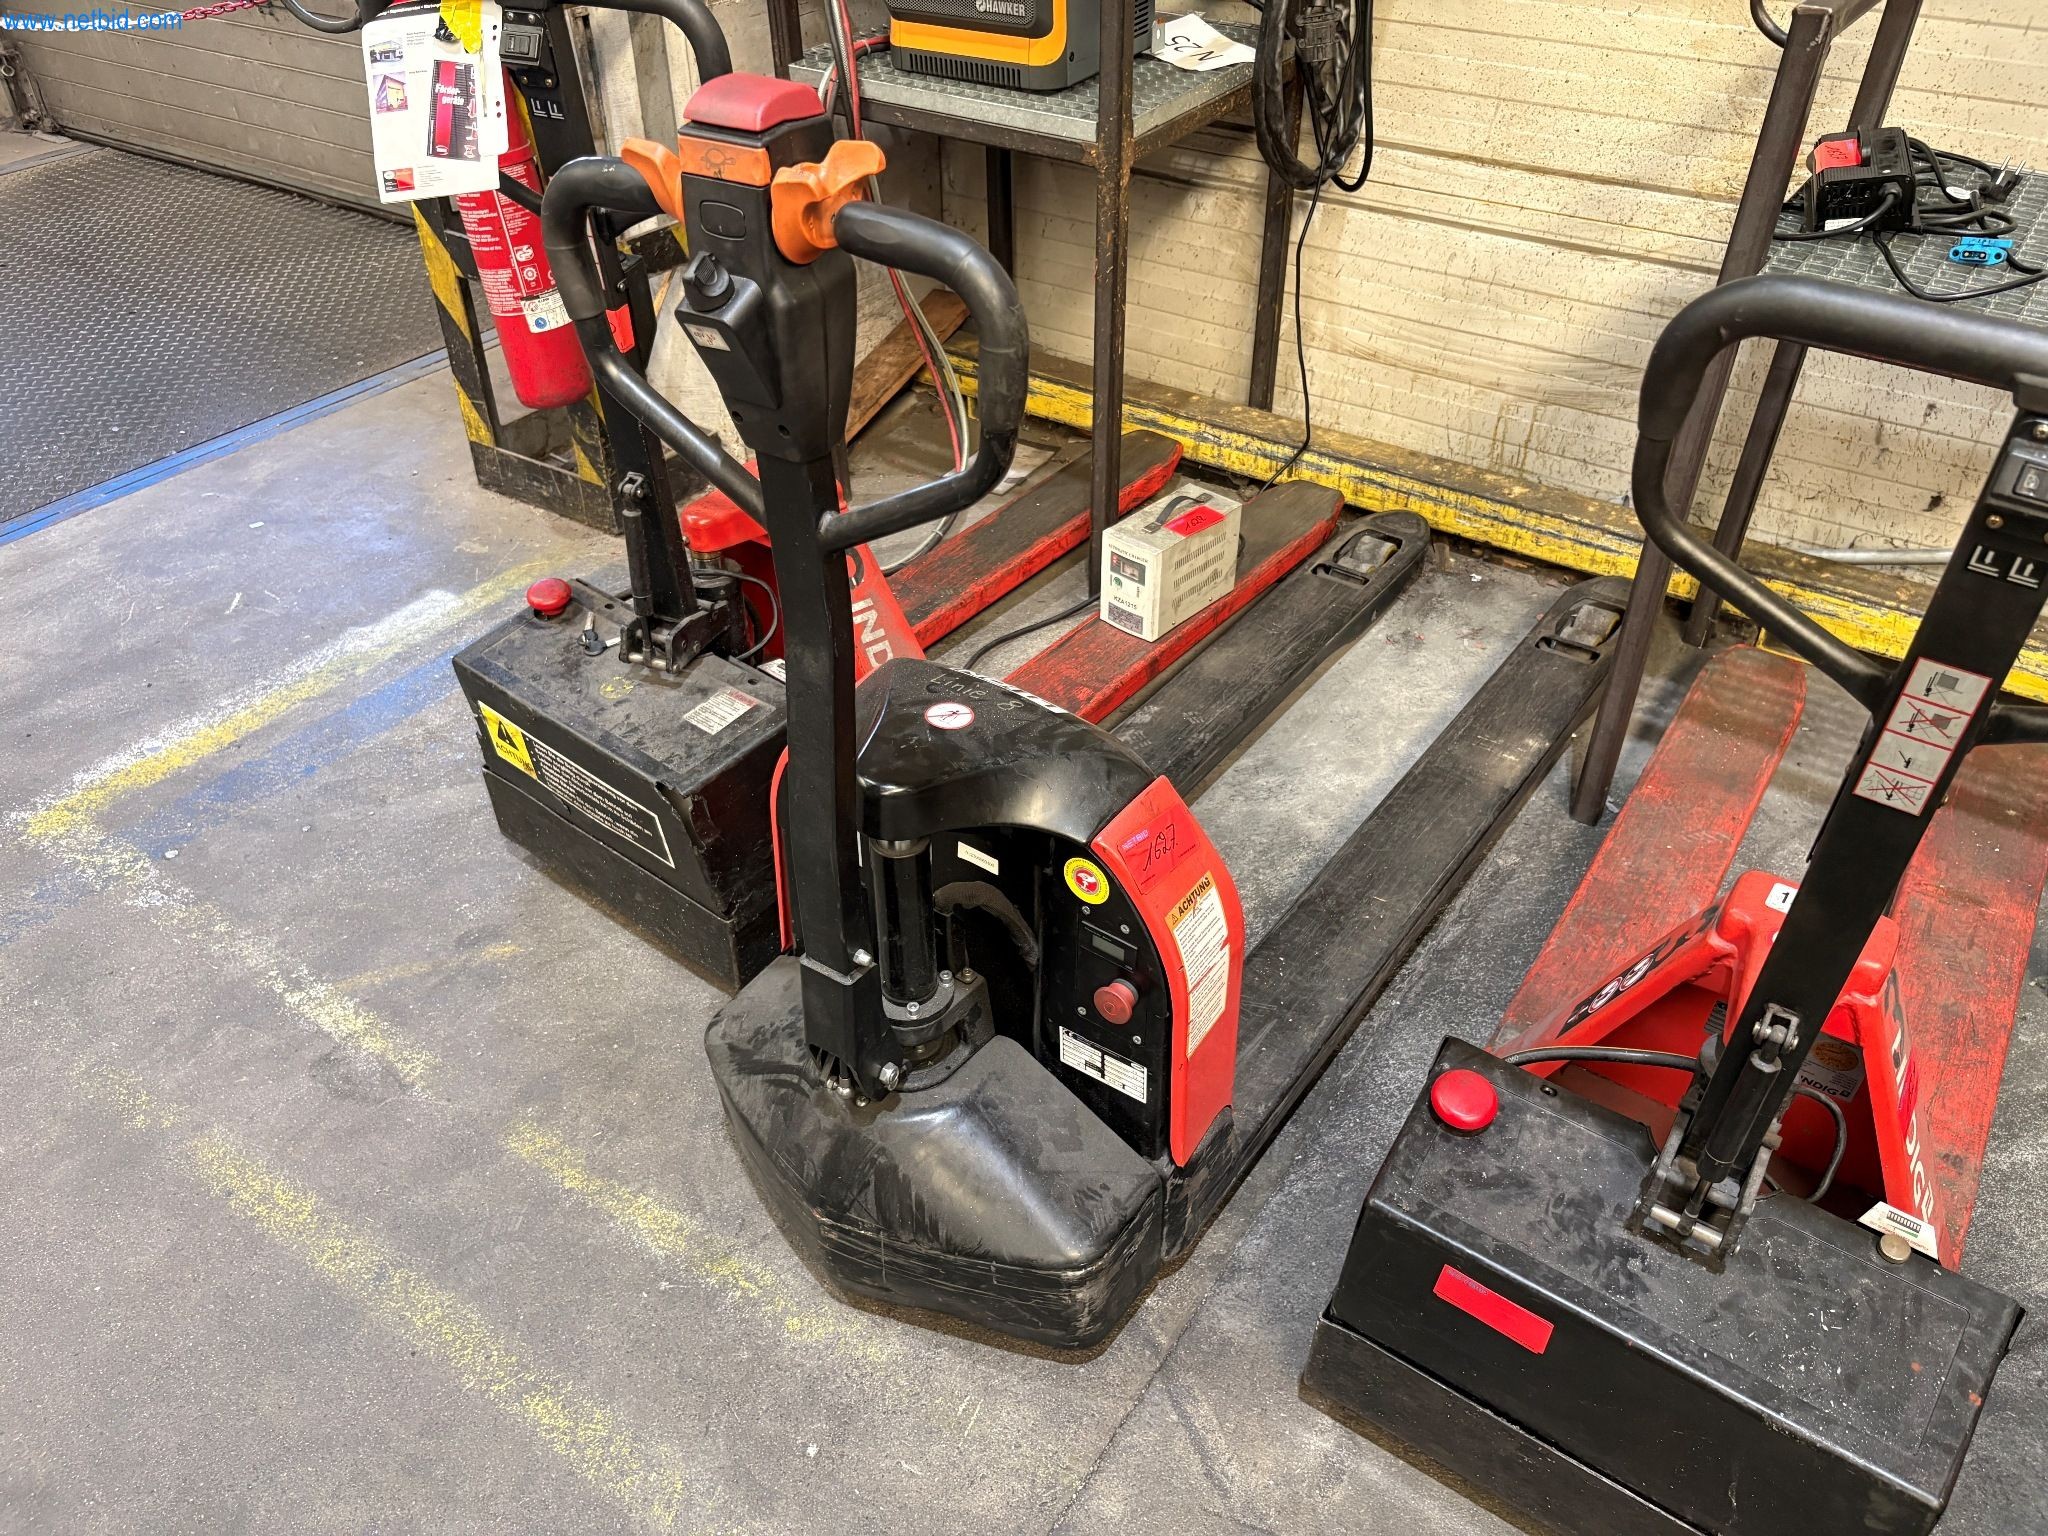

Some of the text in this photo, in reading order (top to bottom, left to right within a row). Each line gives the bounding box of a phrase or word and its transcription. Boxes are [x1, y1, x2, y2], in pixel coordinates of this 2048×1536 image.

[987, 0, 1025, 16] HAWKER
[495, 741, 534, 772] ACHTUNG
[1178, 876, 1211, 917] ACHTUNG
